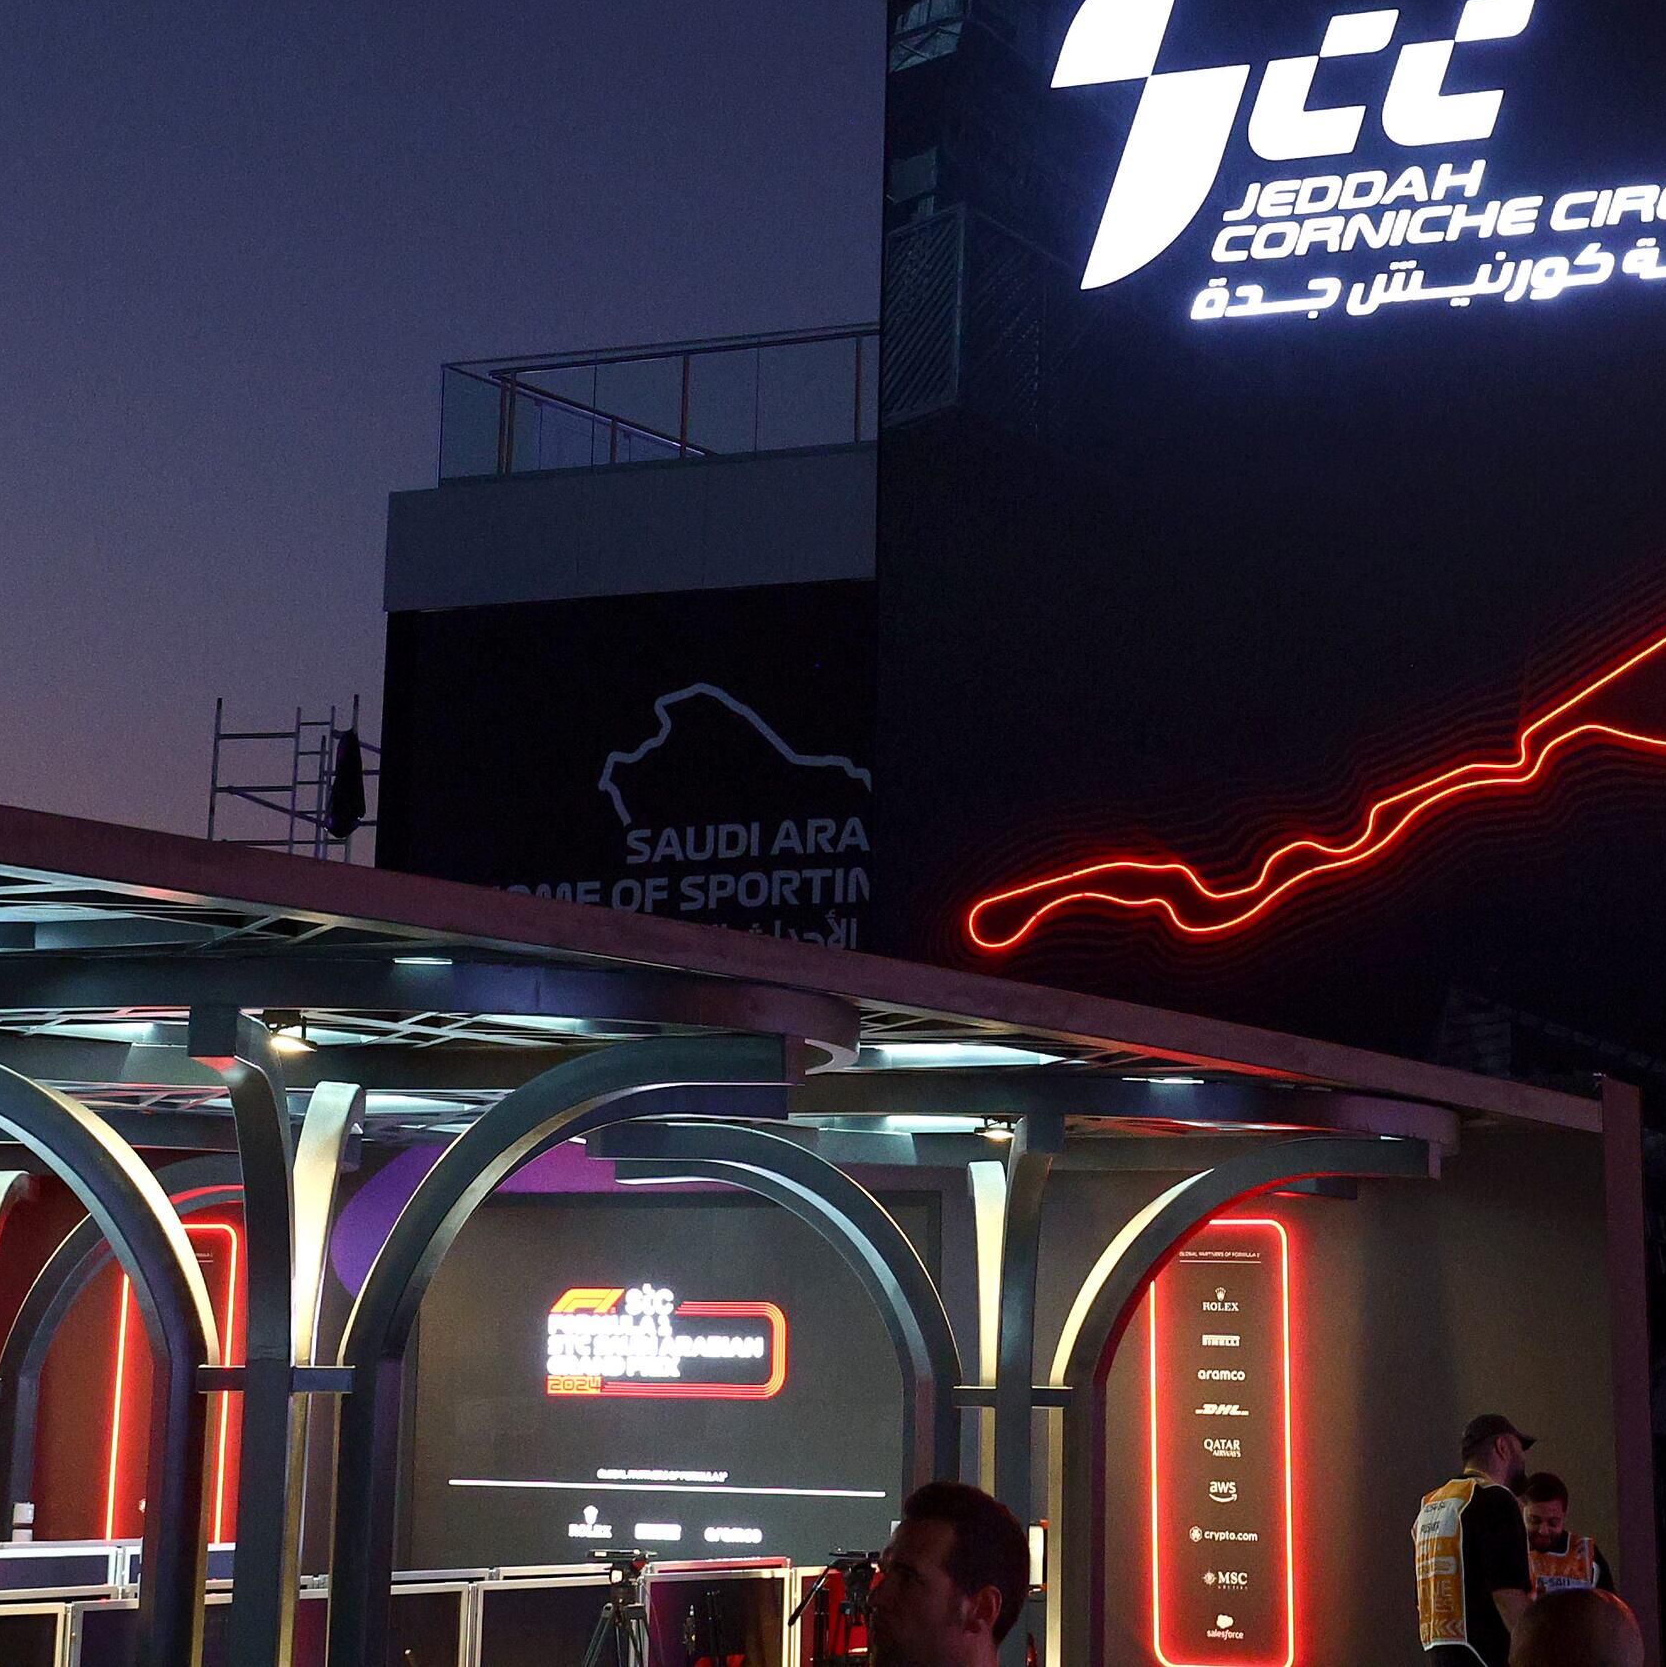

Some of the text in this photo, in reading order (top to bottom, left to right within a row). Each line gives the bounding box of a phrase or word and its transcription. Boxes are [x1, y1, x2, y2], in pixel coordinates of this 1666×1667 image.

[1222, 159, 1486, 222] JEDDAH
[1211, 194, 1544, 263] CORNICHE
[1345, 241, 1615, 317] كورنيش
[1190, 273, 1342, 322] جدة
[626, 816, 870, 865] SAUDI ARA
[611, 877, 670, 913] OF
[679, 867, 870, 911] SPORTIN
[1202, 1302, 1239, 1311] ROLEX
[1197, 1369, 1245, 1381] aramco
[549, 1378, 601, 1392] 2024
[1198, 1404, 1246, 1415] DHL
[1203, 1439, 1240, 1452] QATAR
[1209, 1480, 1237, 1494] aws
[1204, 1529, 1258, 1542] crypto.com
[1218, 1572, 1247, 1585] MSC
[1206, 1629, 1244, 1640] salesforce
